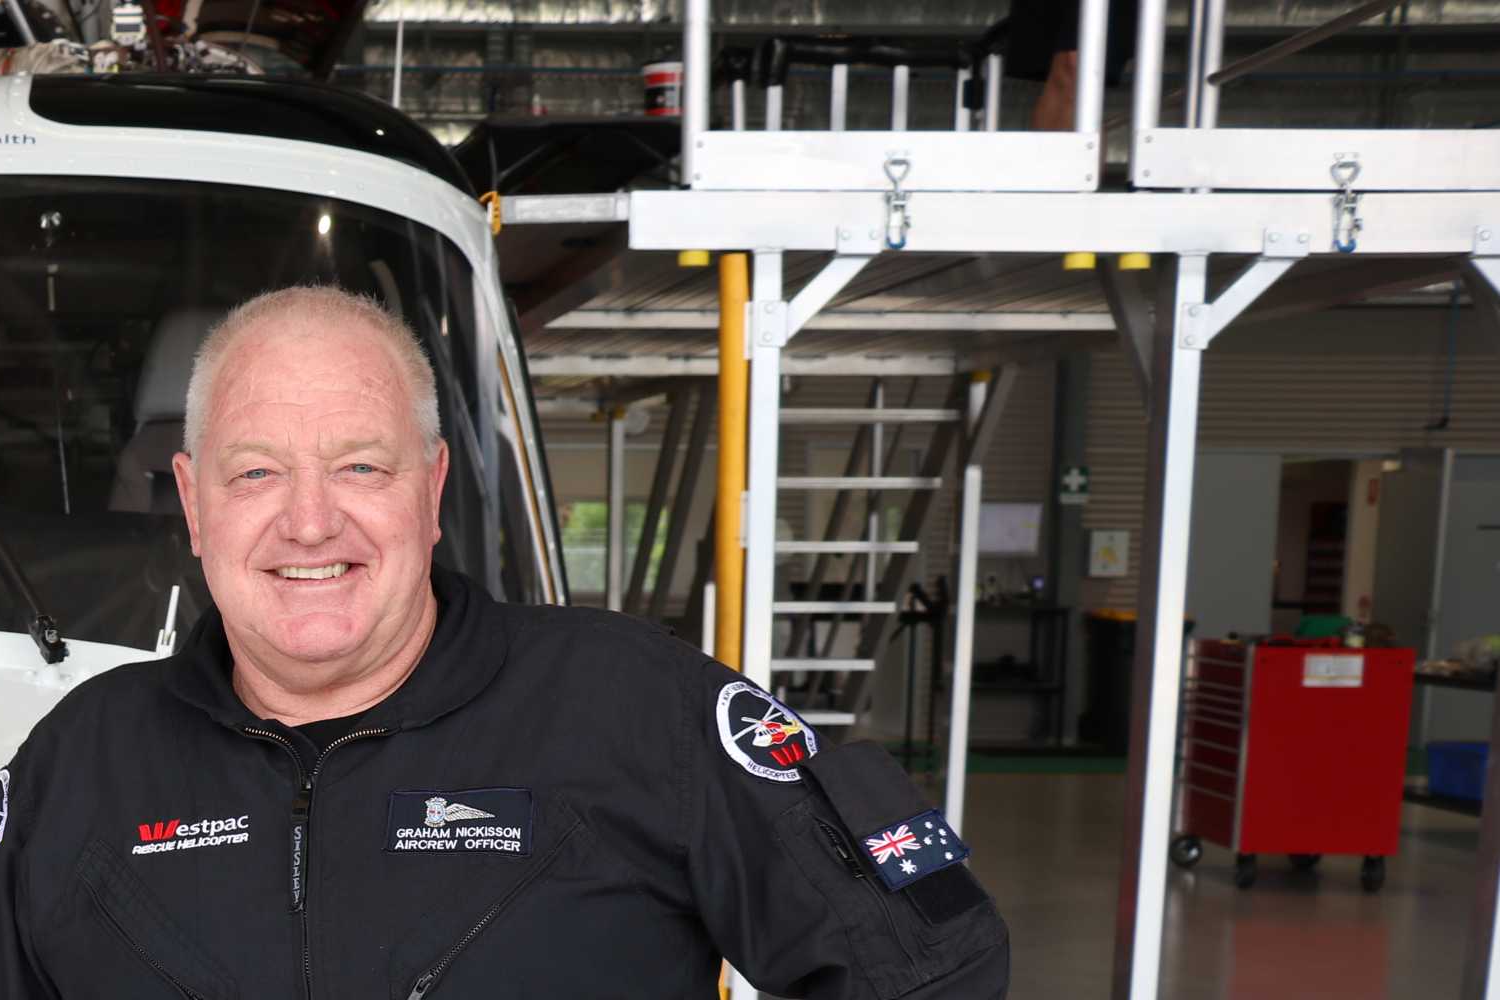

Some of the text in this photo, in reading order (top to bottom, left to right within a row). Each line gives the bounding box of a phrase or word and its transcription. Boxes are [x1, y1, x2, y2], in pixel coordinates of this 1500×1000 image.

[747, 760, 798, 780] HELICOPTER
[138, 815, 249, 842] Westpac
[396, 826, 521, 840] GRAHAM NICKISSON
[132, 832, 249, 855] RESCUE HELICOPTER
[394, 839, 521, 852] AIRCREW OFFICER
